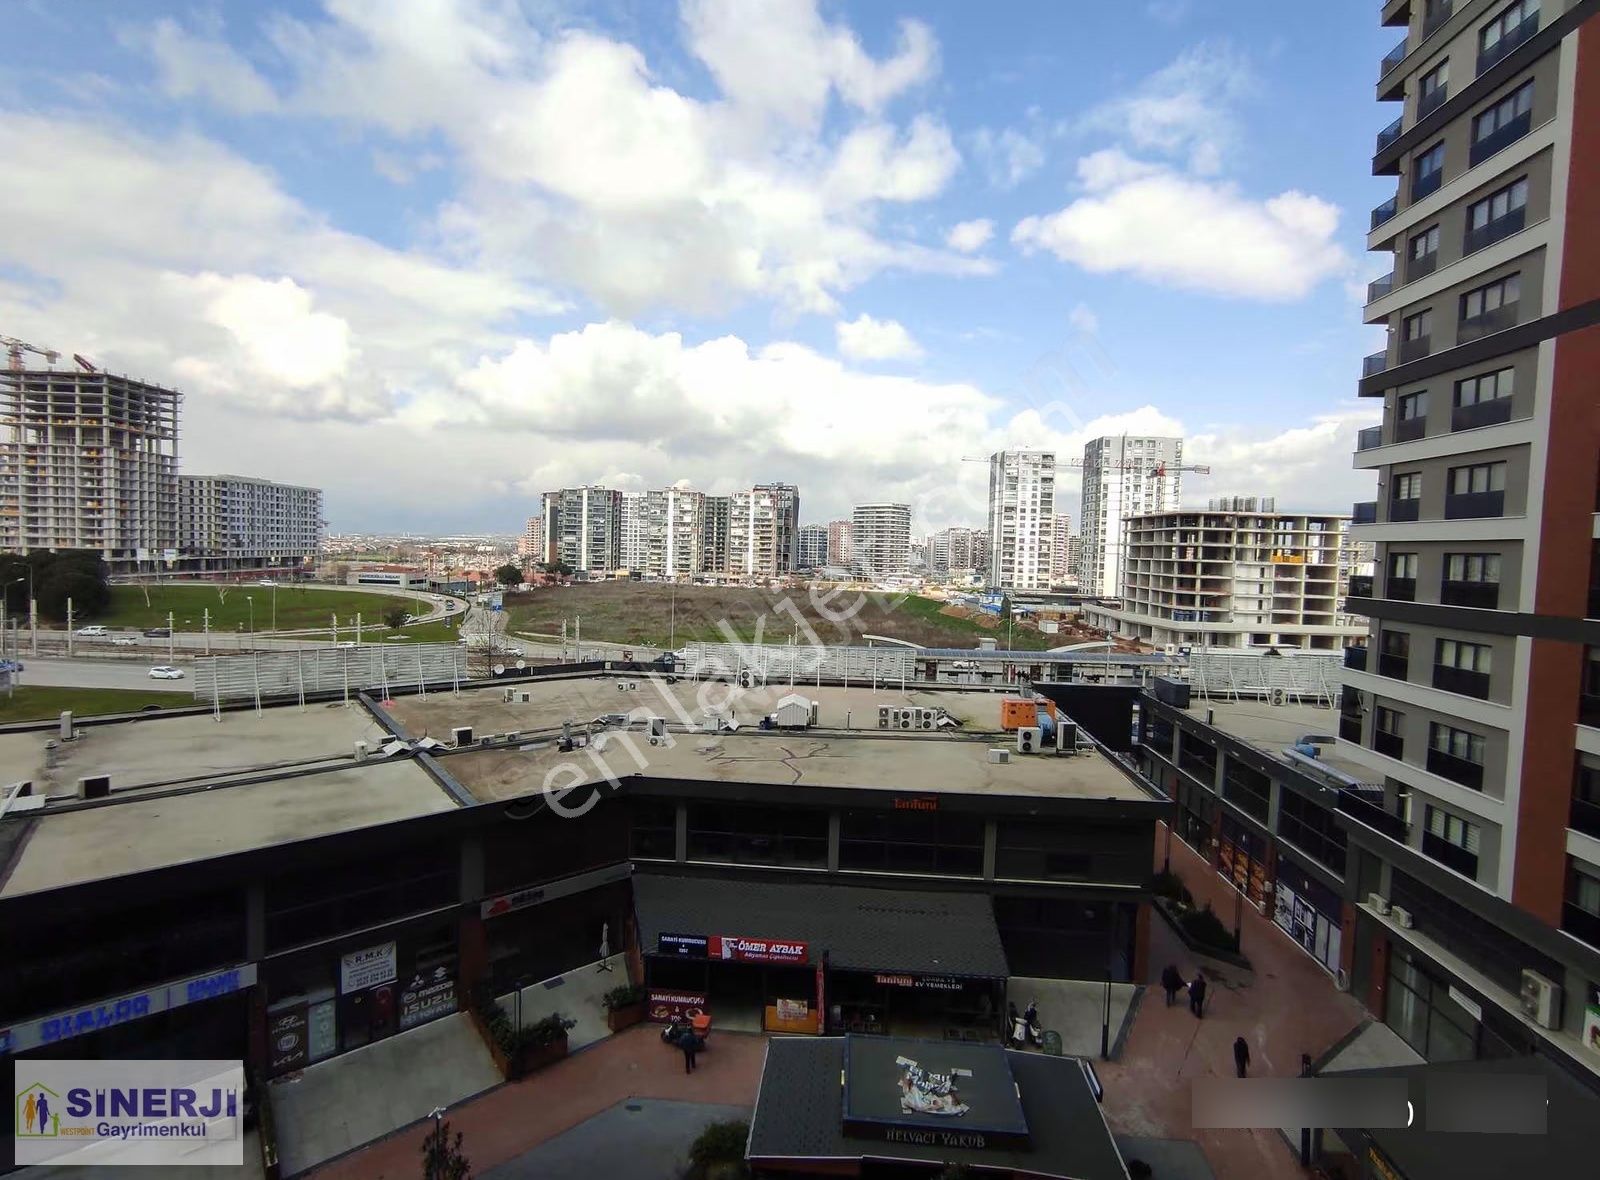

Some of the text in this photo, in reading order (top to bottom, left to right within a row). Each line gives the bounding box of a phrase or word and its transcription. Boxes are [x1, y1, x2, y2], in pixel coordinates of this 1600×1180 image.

[738, 940, 804, 955] ÖMER AYBAK
[403, 991, 454, 1015] ISUZU
[941, 1131, 986, 1148] YAKUB
